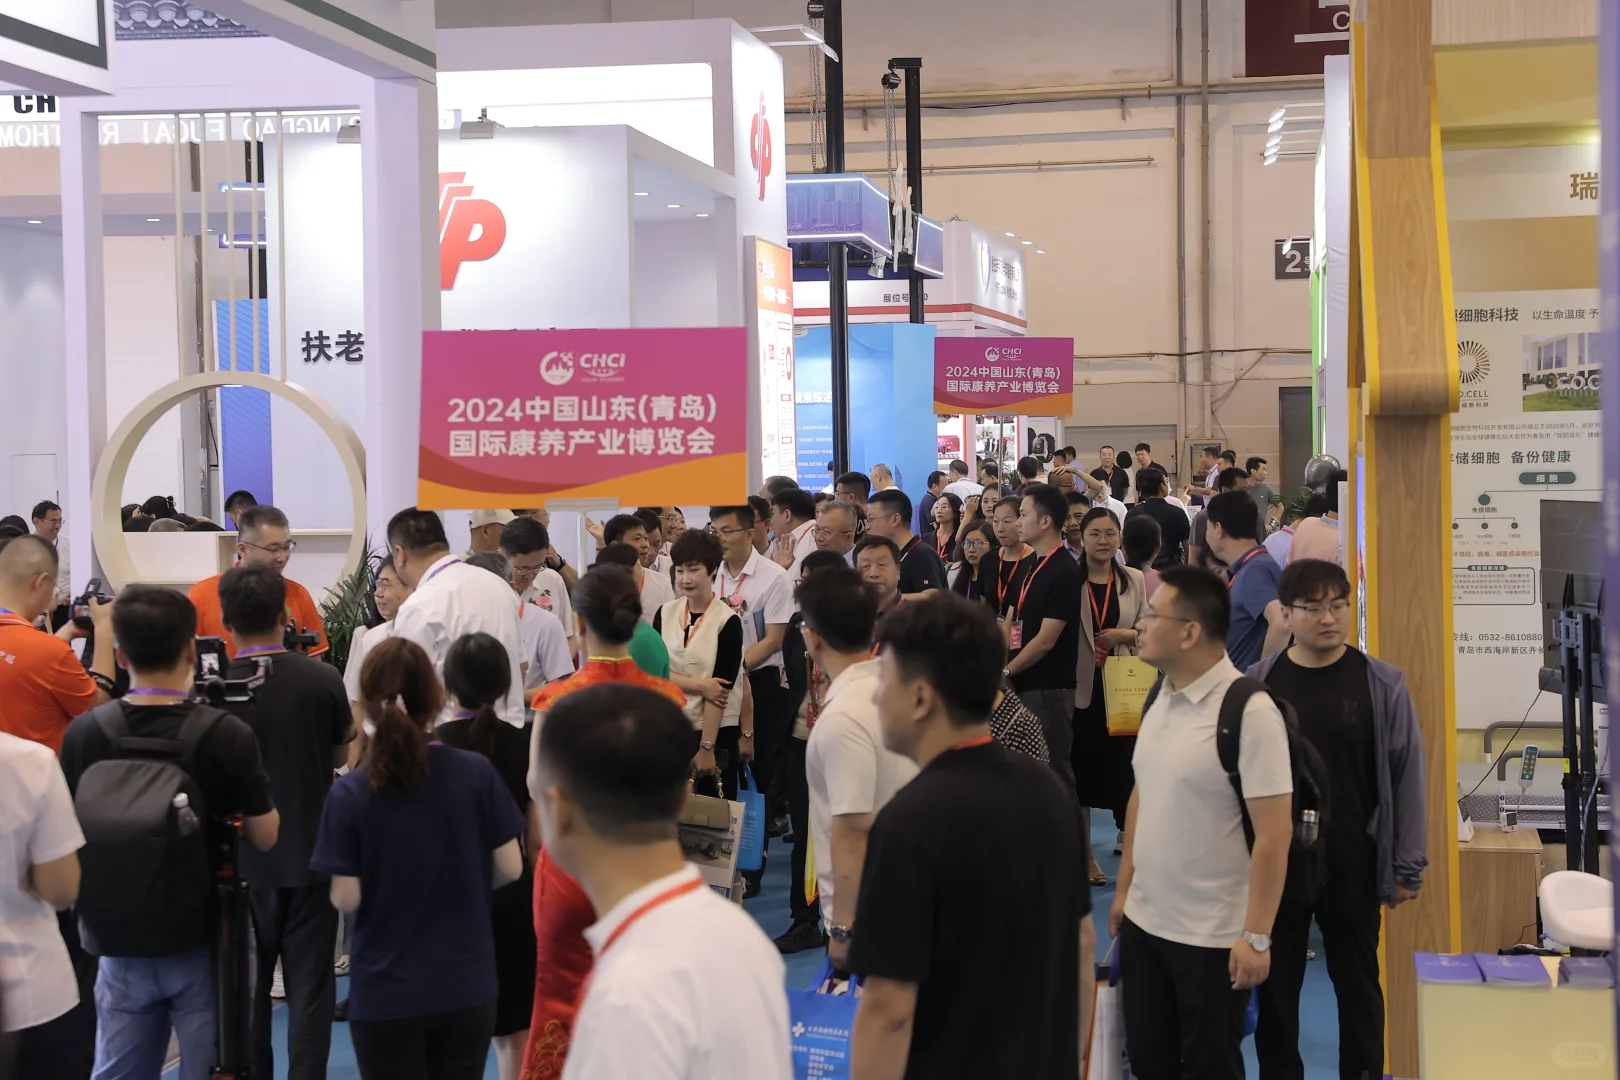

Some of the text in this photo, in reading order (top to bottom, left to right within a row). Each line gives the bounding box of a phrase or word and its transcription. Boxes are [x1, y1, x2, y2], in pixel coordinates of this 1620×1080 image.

[1570, 172, 1600, 200] 瑞
[301, 330, 365, 363] 扶老
[1002, 347, 1022, 355] CHCI
[580, 353, 626, 368] CHCI
[946, 366, 1060, 379] 2024中国山东(青岛)
[946, 380, 1060, 394] 国际康养产业博览会
[447, 394, 717, 423] 2024中国山东(青岛)
[449, 427, 716, 457] 国际康养产业博览会
[1511, 450, 1571, 464] 备份健康
[1535, 474, 1558, 483] 细胞
